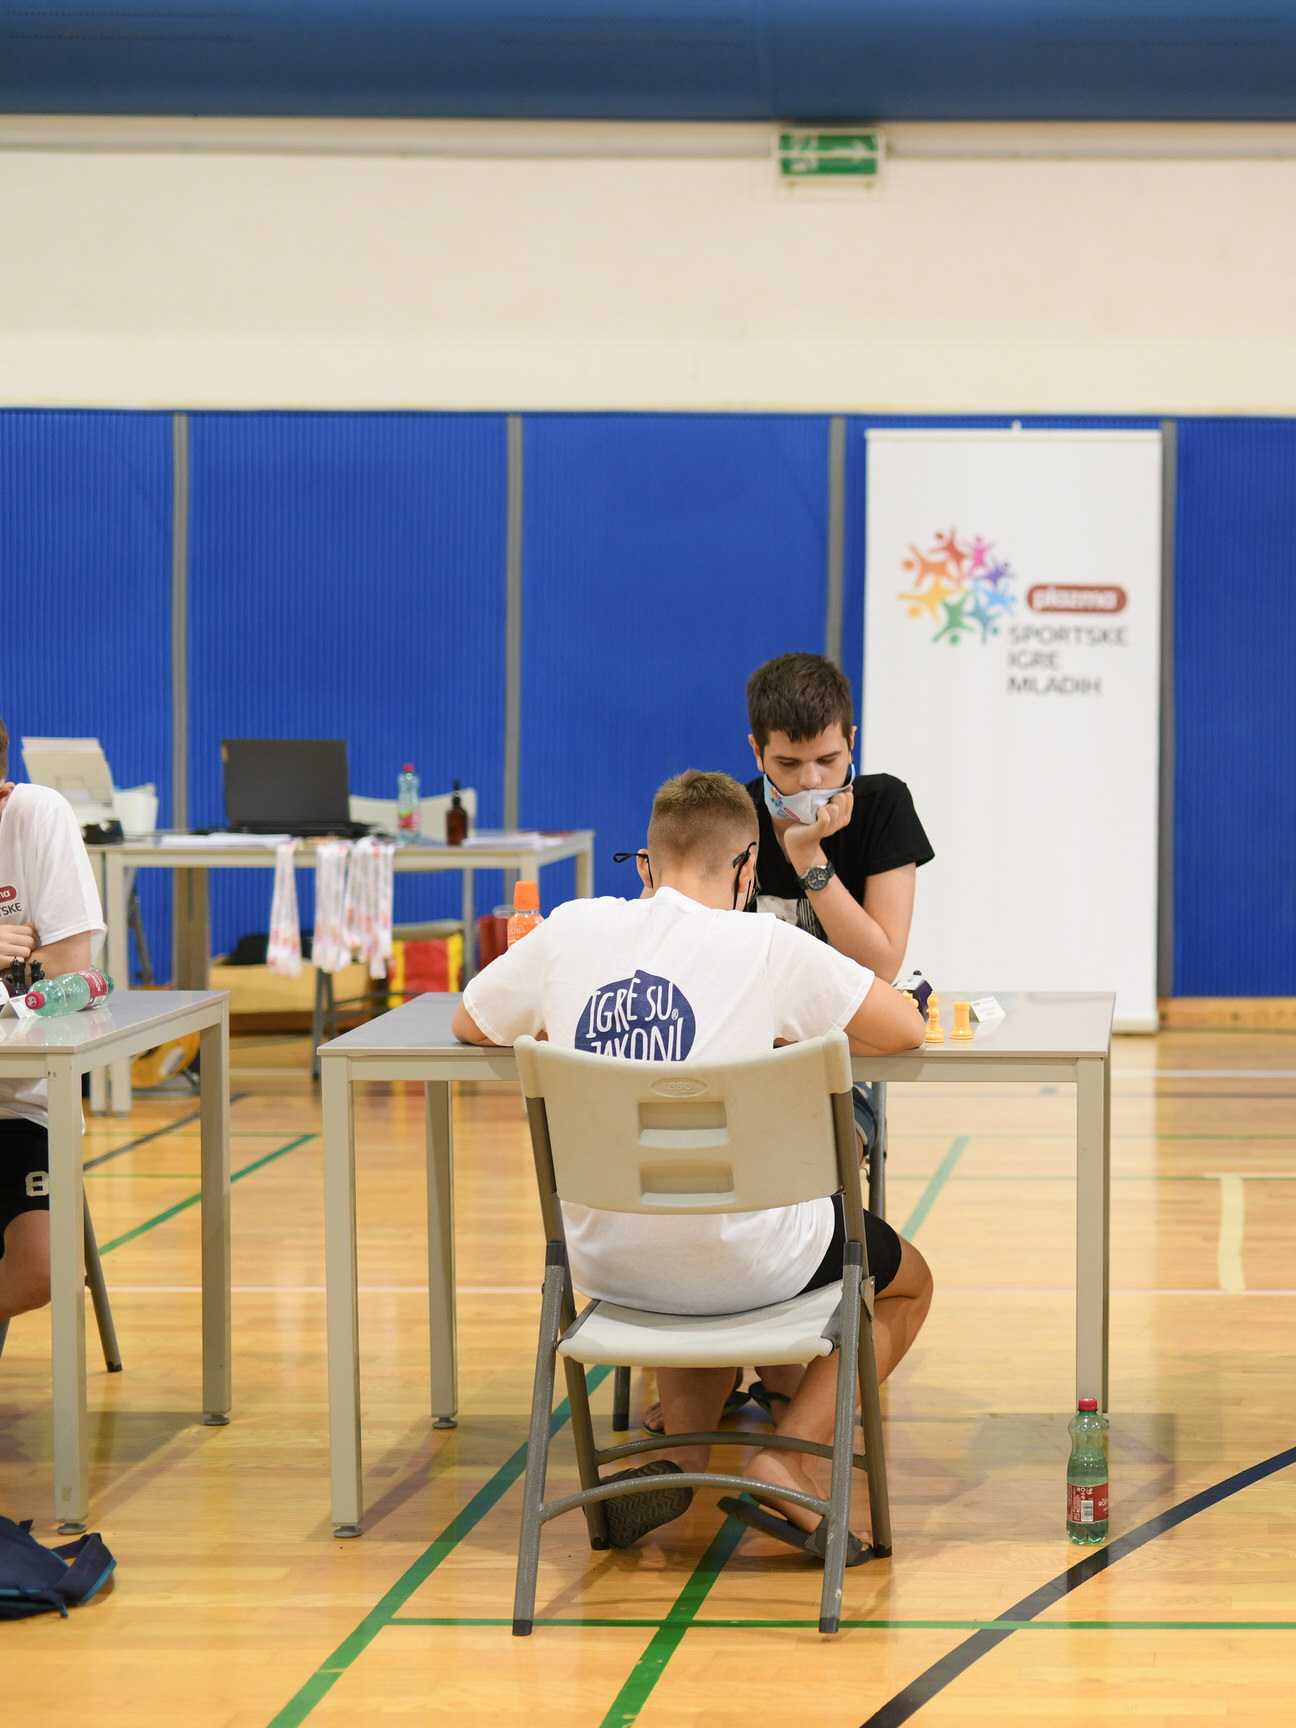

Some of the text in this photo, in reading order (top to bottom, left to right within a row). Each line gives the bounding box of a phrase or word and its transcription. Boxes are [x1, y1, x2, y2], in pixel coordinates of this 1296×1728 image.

[1032, 586, 1118, 611] plazma
[1009, 625, 1128, 647] SPORTSKE
[1008, 650, 1060, 670] IGRE
[1007, 676, 1102, 696] MLADIH
[586, 978, 674, 1039] IGRE SU
